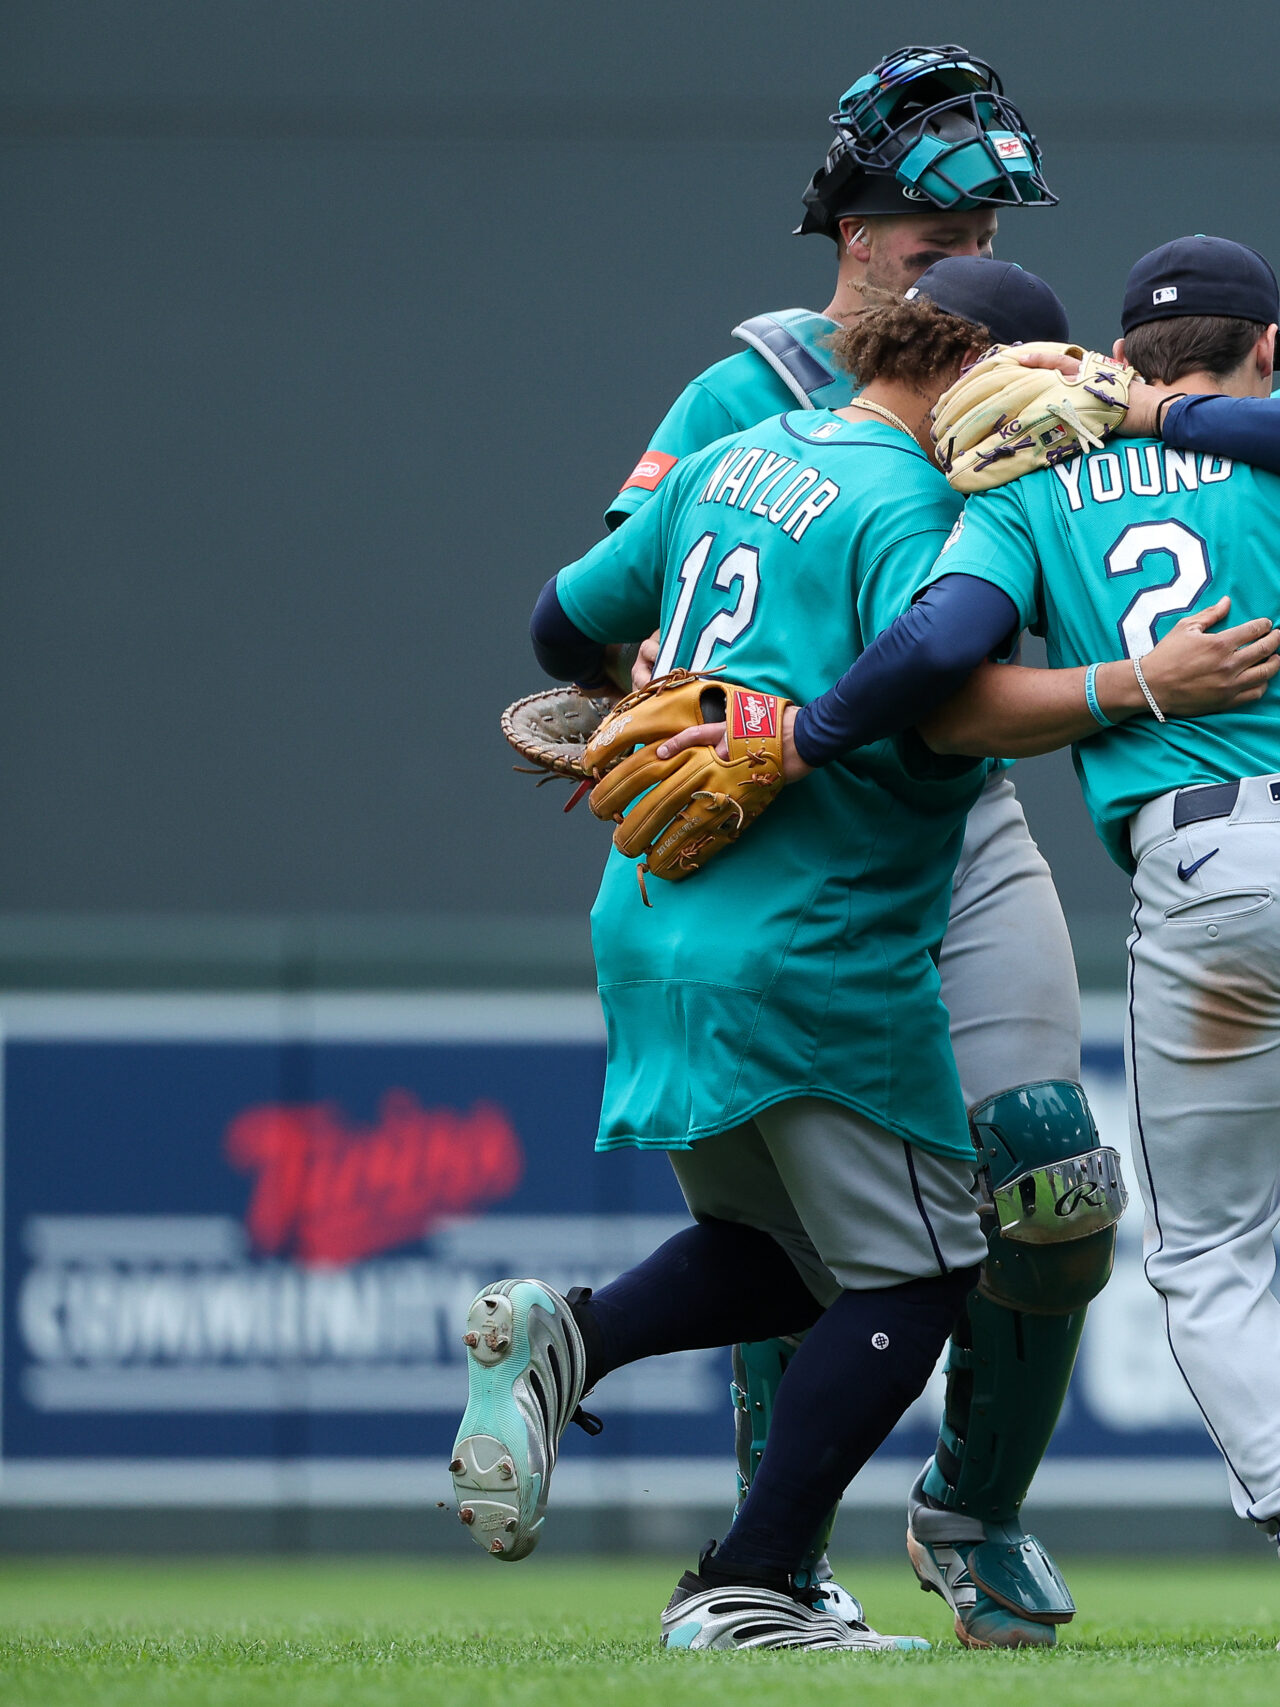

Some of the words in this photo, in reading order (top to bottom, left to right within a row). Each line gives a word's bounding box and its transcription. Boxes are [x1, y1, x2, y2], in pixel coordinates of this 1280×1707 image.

[999, 418, 1023, 439] KC
[1051, 444, 1234, 513] YOUNG
[696, 446, 842, 545] NAYLOR
[650, 530, 762, 684] 12
[1103, 517, 1213, 660] 2
[227, 1092, 523, 1270] Twins
